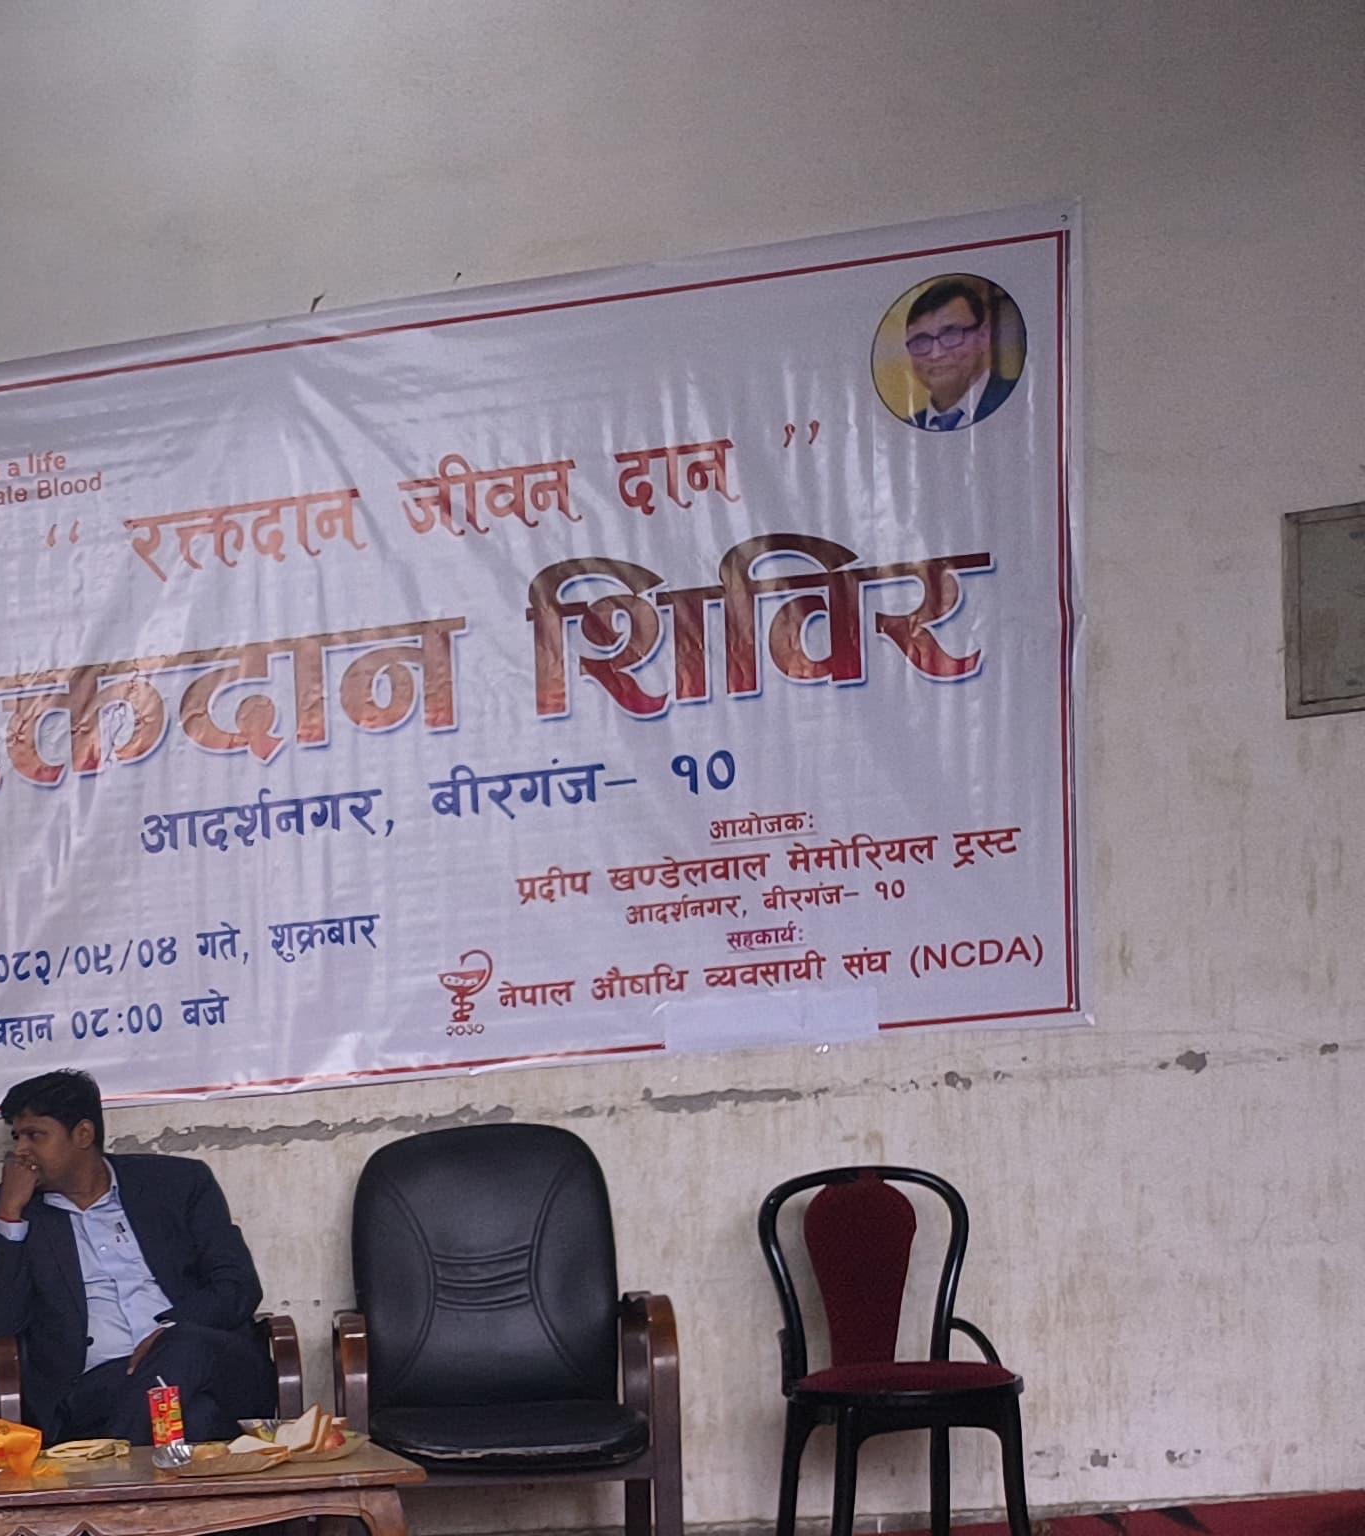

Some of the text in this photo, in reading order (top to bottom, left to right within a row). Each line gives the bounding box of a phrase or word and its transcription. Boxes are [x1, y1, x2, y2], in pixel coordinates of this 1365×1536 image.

[7, 461, 21, 478] a
[27, 451, 67, 475] life
[36, 471, 103, 500] Blood
[123, 488, 368, 583] रक्तदान
[397, 453, 583, 537] जीवन
[613, 438, 742, 517] दान
[525, 532, 995, 719] शिविर
[140, 787, 395, 854] आदर्शनगर,
[670, 749, 736, 796] १०
[515, 827, 1021, 905] प्रदीप खण्डेलवाल मेमोरियल ट्रस्ट
[626, 893, 748, 925] आदर्शनगर,
[874, 879, 906, 901] १०
[196, 921, 250, 966] गते,
[497, 933, 1045, 1008] नेपाल औषधि व्यवसायी संघ (NCDA)
[180, 988, 230, 1027] बजे
